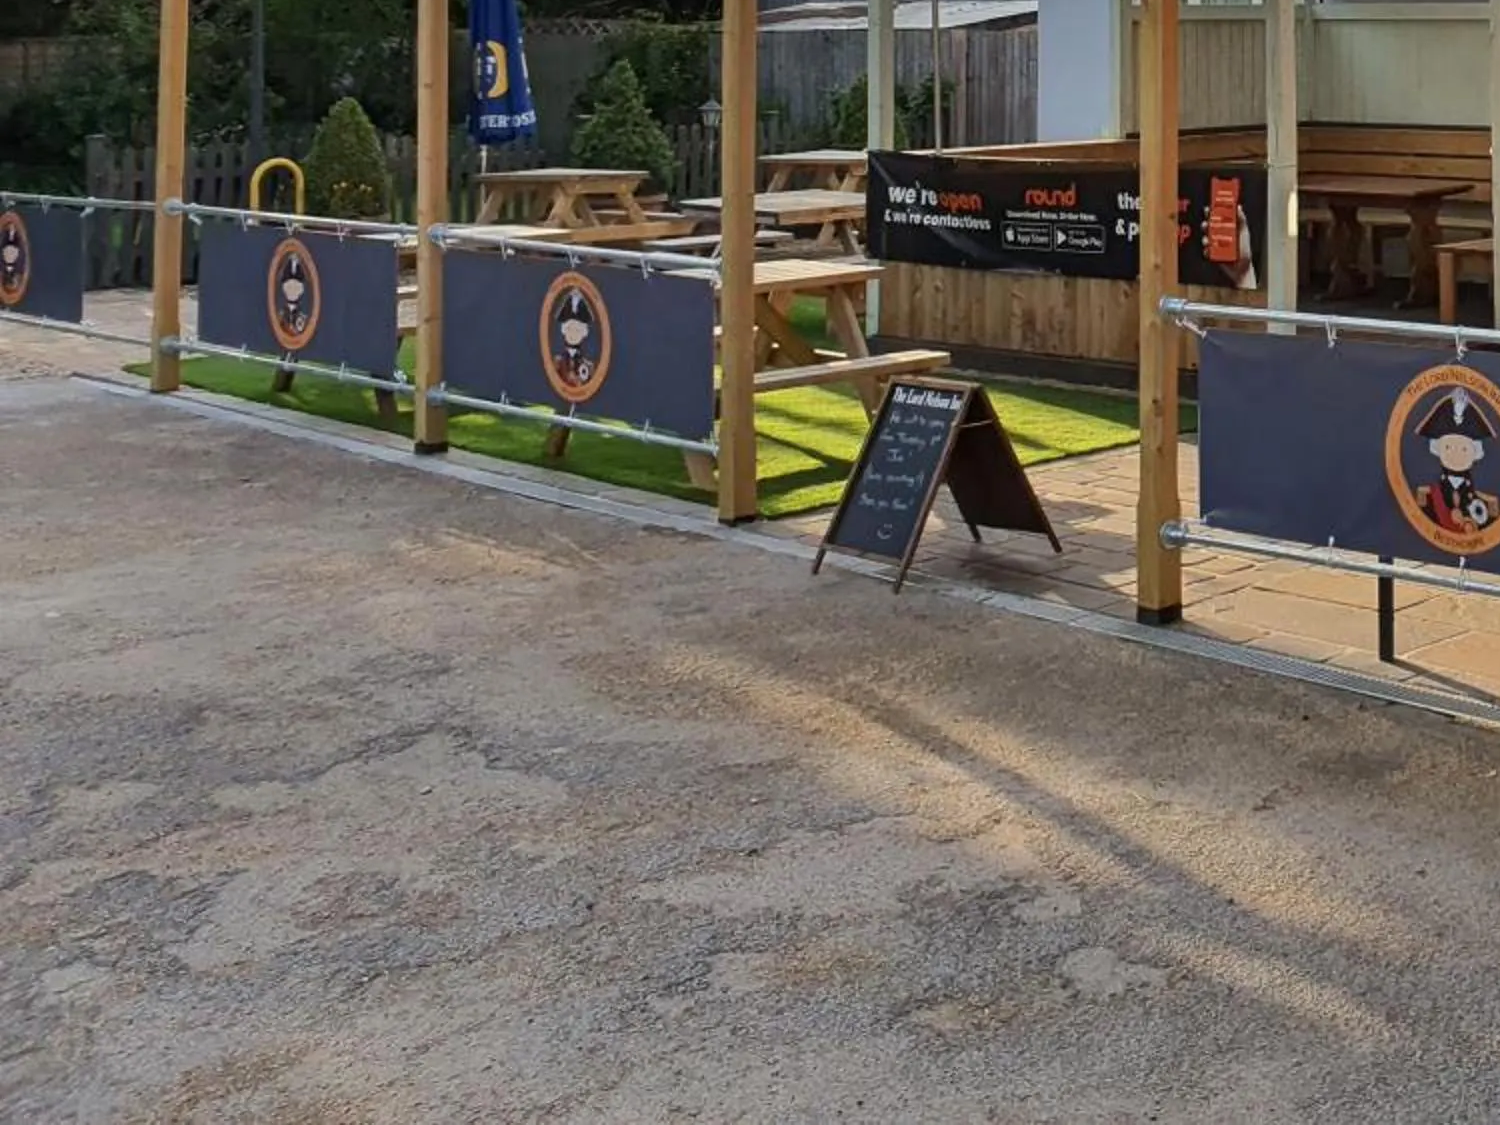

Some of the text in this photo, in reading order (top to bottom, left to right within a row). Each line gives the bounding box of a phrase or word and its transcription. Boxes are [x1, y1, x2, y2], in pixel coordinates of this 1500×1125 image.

[888, 180, 982, 213] we're open
[1025, 181, 1076, 206] round
[884, 208, 991, 230] & we're contactless
[1115, 219, 1126, 235] &
